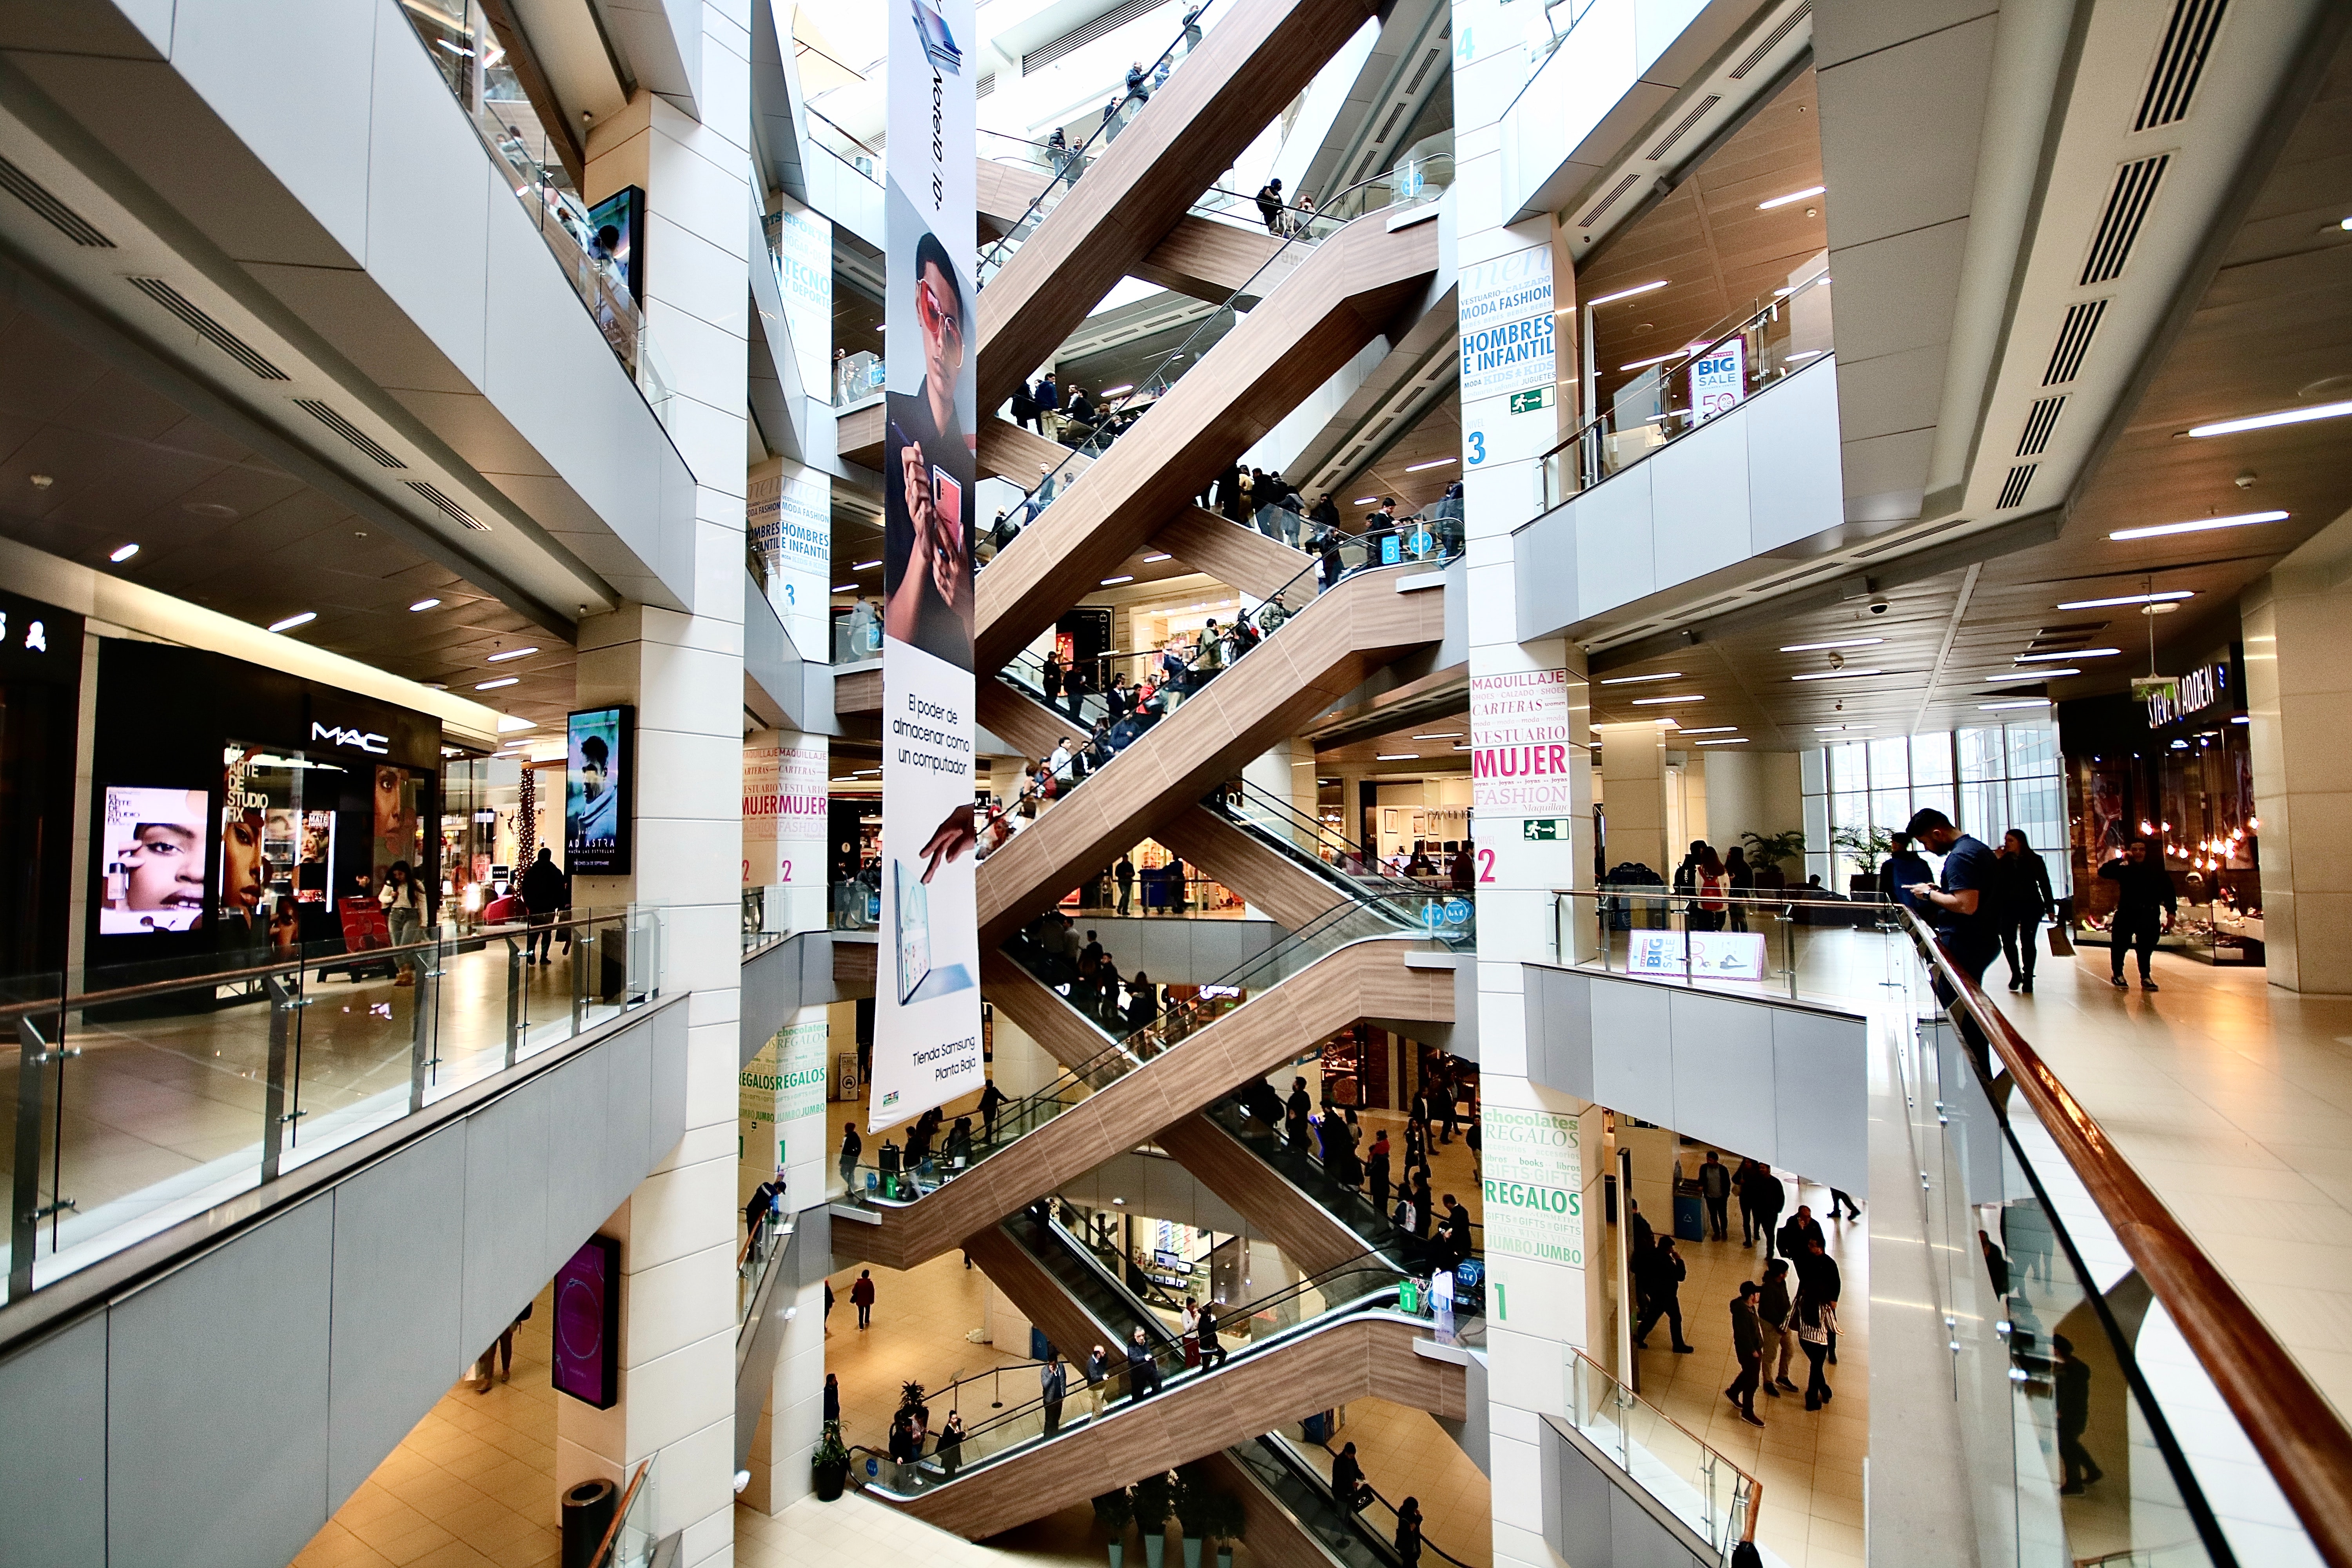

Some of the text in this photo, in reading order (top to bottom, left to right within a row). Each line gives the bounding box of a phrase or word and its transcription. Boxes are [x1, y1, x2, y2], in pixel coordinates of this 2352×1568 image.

[1456, 27, 1475, 60] 4
[784, 212, 830, 246] SPORTS
[784, 233, 808, 255] HOGAR
[784, 256, 830, 295] TECNO
[1460, 247, 1550, 293] men
[784, 276, 830, 310] Y DEPORTE
[1461, 275, 1551, 306] VESTUARIO CALZADO
[1461, 285, 1551, 321] MODA FASHION
[1461, 319, 1481, 330] BEBÉS
[1484, 313, 1504, 323] BEBÉS
[1507, 308, 1528, 317] BEBÉS
[1463, 315, 1554, 355] HOMBRES
[1464, 336, 1554, 374] E INFANTIL
[1464, 360, 1555, 388] MODA KIDS KIDS
[1699, 358, 1735, 376] BIG
[1521, 372, 1556, 385] JUGUETES
[1699, 373, 1736, 387] SALE
[1466, 418, 1485, 430] NIVEL
[1468, 431, 1486, 465] 3
[759, 501, 780, 515] FASHION
[782, 495, 804, 506] VESTUARIO
[782, 501, 801, 515] MODA
[803, 508, 829, 523] FASHION
[782, 522, 829, 546] HOMBRES
[782, 537, 786, 548] E
[789, 539, 829, 561] INFANTIL
[1386, 546, 1395, 560] 3
[785, 584, 795, 606] 3
[1472, 670, 1565, 691] MAQUILLAJE
[2173, 664, 2214, 718] MADDEN
[1501, 690, 1534, 698] CALZADO
[1541, 687, 1566, 695] SHOES
[909, 693, 957, 725] El poder de
[1473, 699, 1543, 716] CARTERAS
[893, 717, 969, 752] almacenar como
[1474, 726, 1566, 744] VESTUARIO
[779, 748, 827, 760] MAQUILLAJE
[898, 748, 967, 776] un computador
[1474, 745, 1568, 779] MUJER
[228, 759, 259, 778] ARTE
[779, 765, 815, 775] CARTERAS
[228, 775, 245, 791] DE
[779, 783, 827, 794] VESTUARIO
[227, 790, 269, 809] STUDIO
[779, 795, 826, 815] MUJER
[1475, 786, 1568, 806] FASHION
[227, 806, 245, 822] FIX
[1523, 803, 1568, 813] Maquillaje
[309, 815, 329, 824] MATE
[779, 822, 826, 833] FASHION
[569, 838, 615, 848] AD ASTRA
[1478, 836, 1496, 845] NIVEL
[742, 860, 750, 882] 2
[782, 860, 792, 882] 2
[1478, 849, 1496, 883] 2
[1647, 938, 1664, 967] BIG
[1663, 939, 1675, 968] SALE
[777, 1024, 826, 1038] chocolates
[777, 1032, 826, 1049] REGALOS
[913, 1036, 975, 1067] Tienda Samsung
[776, 1067, 825, 1090] REGALOS
[935, 1056, 976, 1082] Planta Baja
[755, 1111, 774, 1122] JUMBO
[776, 1103, 825, 1122] JUMBO JUMBO
[1483, 1109, 1578, 1131] chocolates
[1485, 1123, 1579, 1149] REGALOS
[779, 1140, 786, 1164] 1
[1485, 1153, 1581, 1172] libros books libros
[1535, 1149, 1580, 1160] accesorios
[1485, 1163, 1581, 1187] GIFTS GIFTS
[1485, 1180, 1581, 1216] REGALOS
[1486, 1212, 1581, 1235] GIFTS GIFTS GIFTS
[1487, 1235, 1581, 1264] JUMBO JUMBO
[1404, 1292, 1411, 1308] 1
[1494, 1283, 1507, 1321] 1
